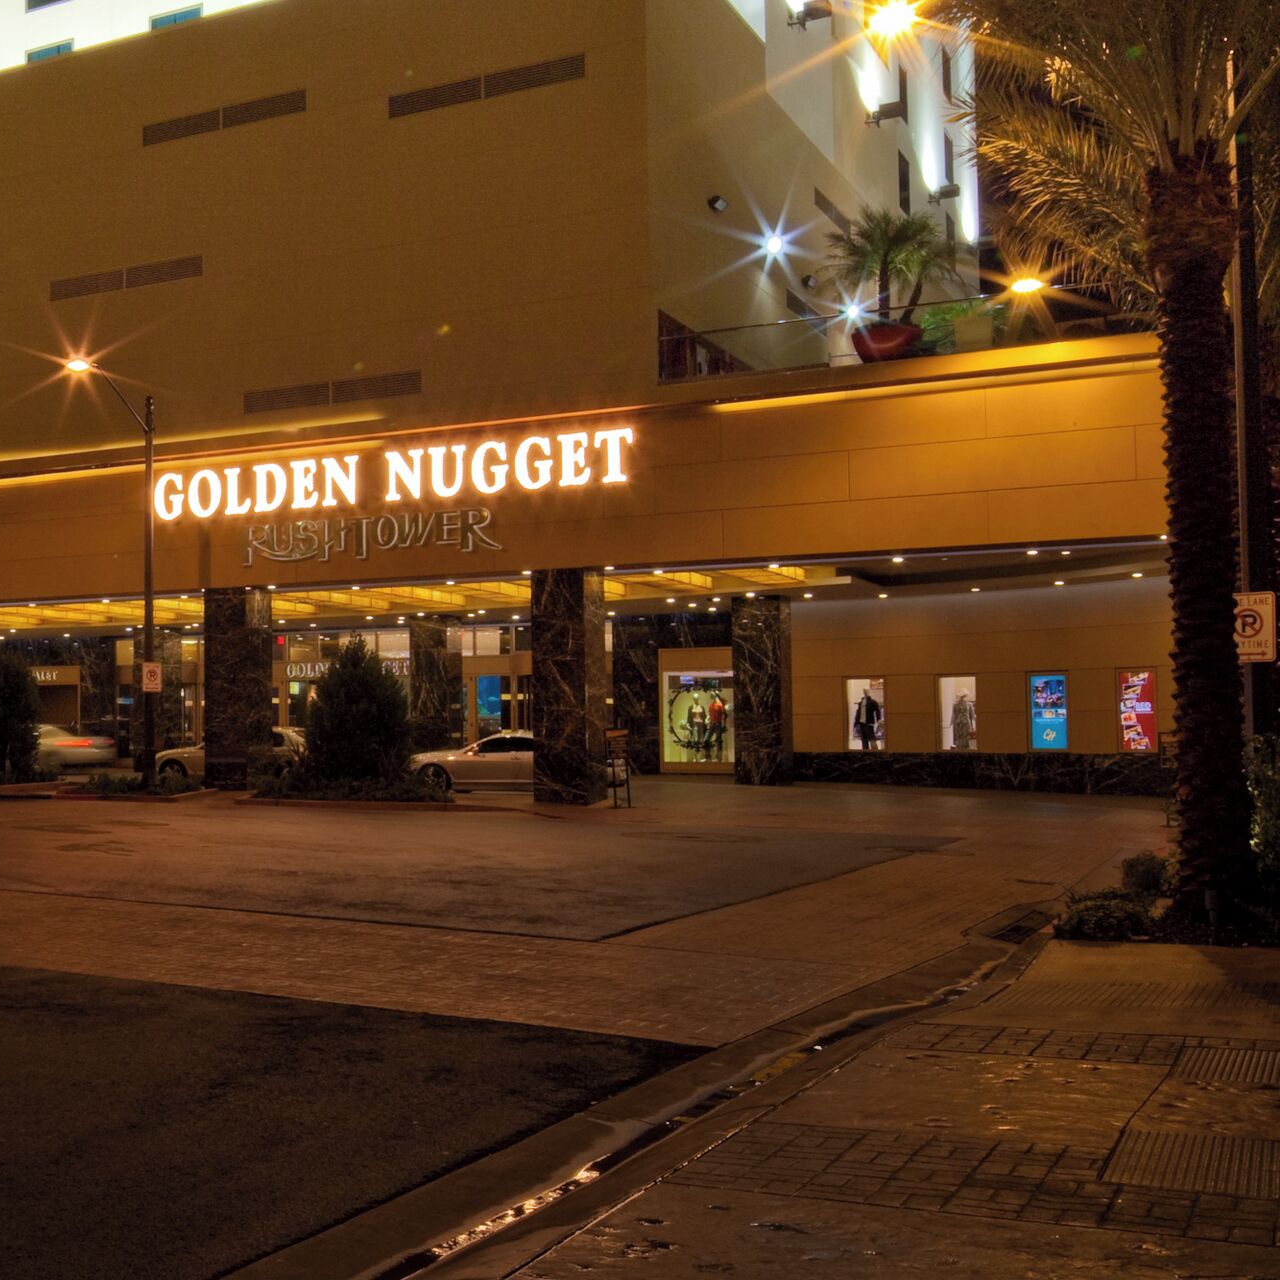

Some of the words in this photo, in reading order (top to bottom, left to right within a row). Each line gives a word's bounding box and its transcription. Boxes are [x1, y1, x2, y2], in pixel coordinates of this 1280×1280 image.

[155, 456, 358, 520] GOLDEN
[386, 428, 633, 500] NUGGET
[242, 516, 350, 567] RUSH
[348, 507, 504, 559] TOWER
[1247, 596, 1270, 606] LANE
[1238, 639, 1270, 649] YTIME
